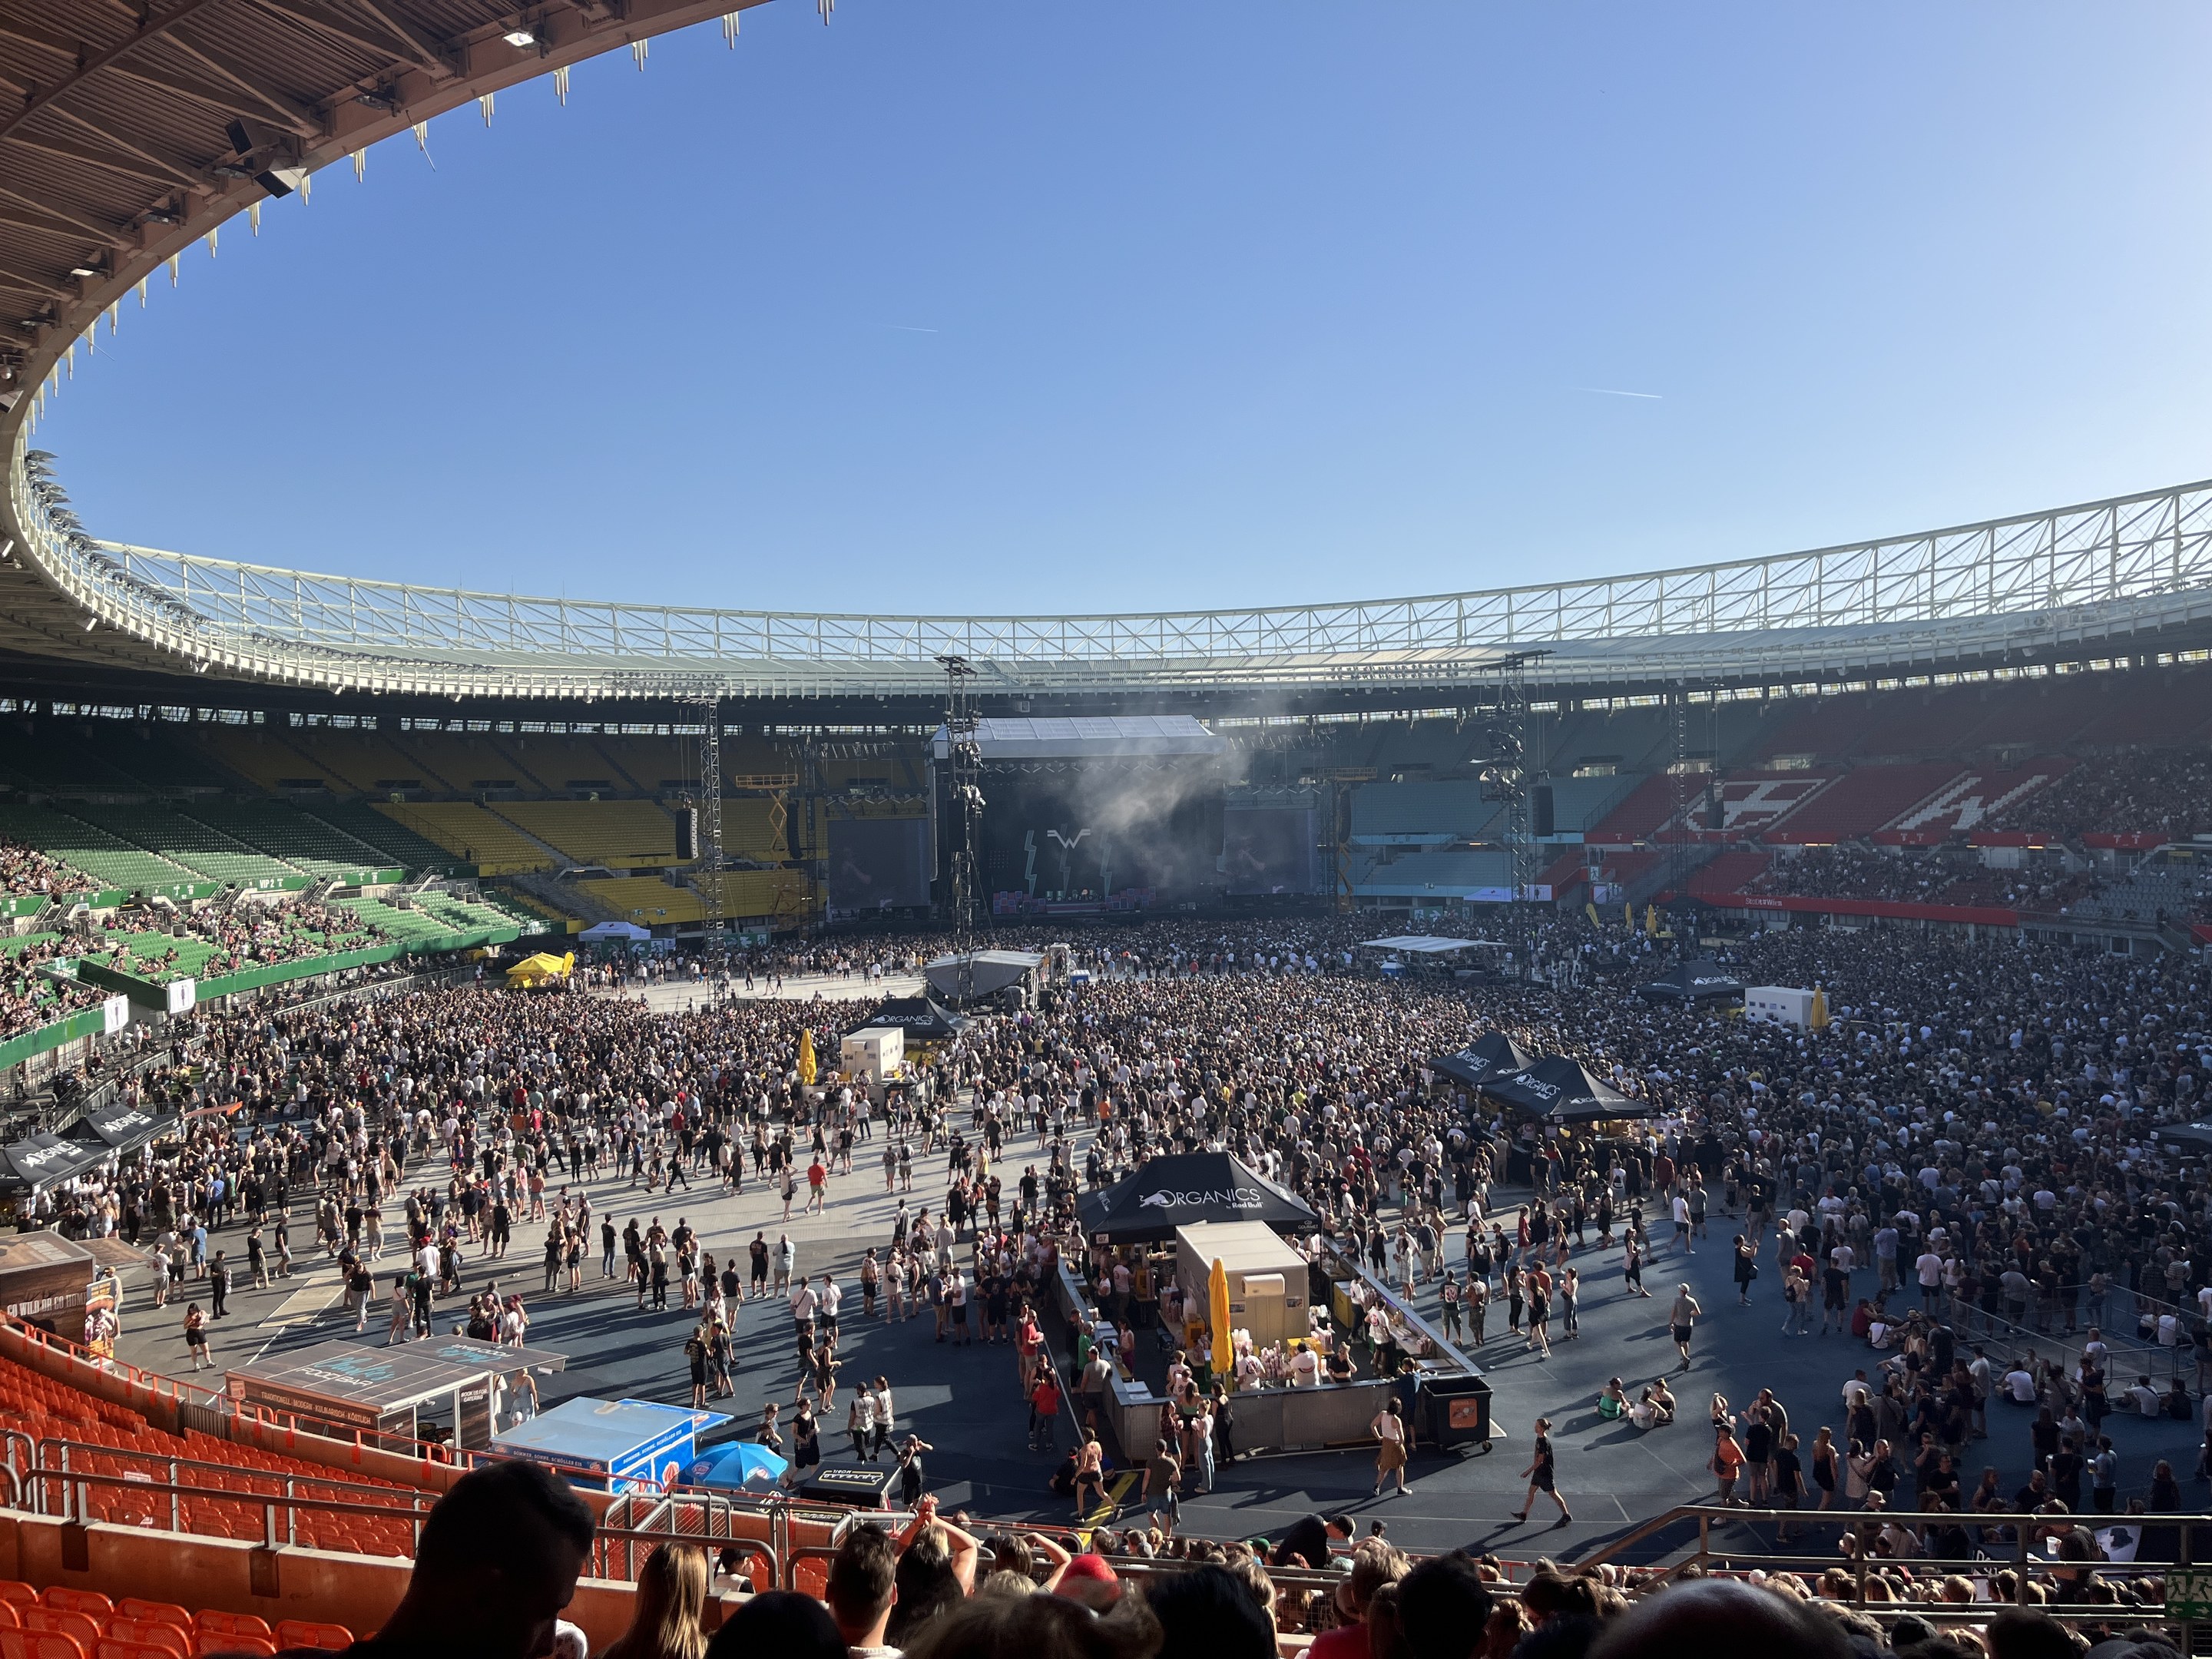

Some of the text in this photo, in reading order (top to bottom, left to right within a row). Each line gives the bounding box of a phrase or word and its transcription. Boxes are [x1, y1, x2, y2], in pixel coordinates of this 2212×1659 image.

[260, 879, 275, 889] VIP 2
[881, 1014, 934, 1024] ORGANICS
[1516, 1073, 1561, 1096] ORGANICS
[1156, 1187, 1261, 1207] ORGANICS
[7, 1304, 18, 1318] GO
[19, 1300, 40, 1316] WILD
[41, 1297, 52, 1312] OR
[54, 1295, 65, 1310] GO
[296, 1367, 373, 1387] FOOD BAR
[261, 1391, 291, 1406] TRADITIONELL
[293, 1399, 313, 1411] MODERN
